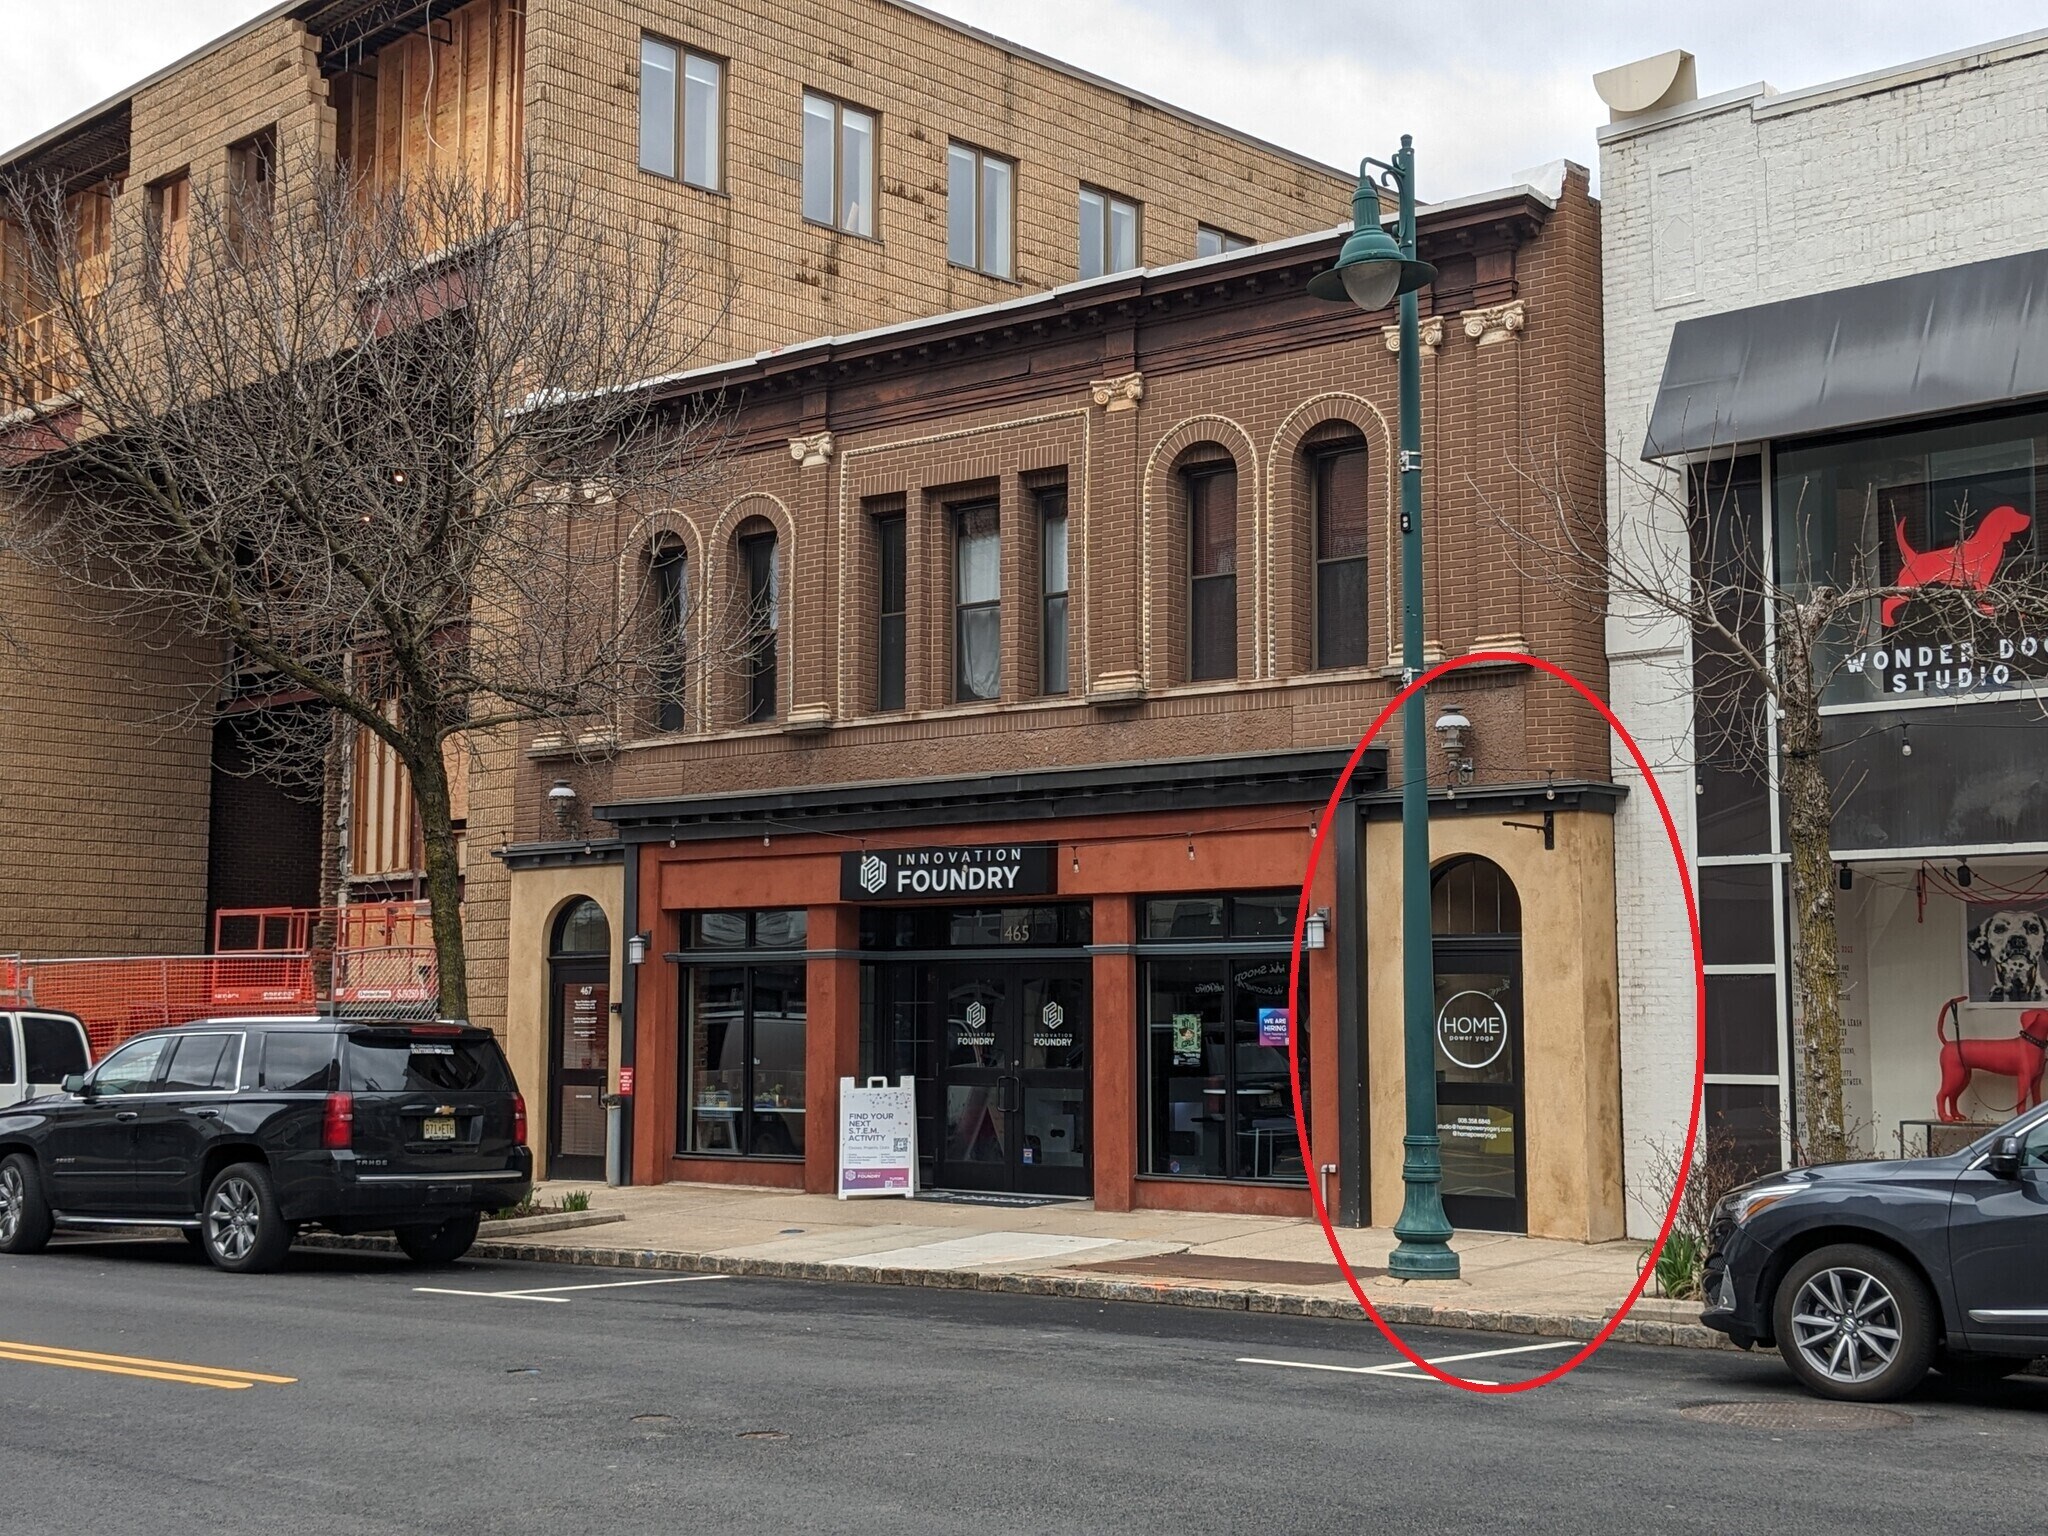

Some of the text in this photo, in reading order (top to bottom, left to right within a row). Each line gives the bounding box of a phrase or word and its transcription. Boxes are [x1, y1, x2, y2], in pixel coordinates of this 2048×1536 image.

[1844, 636, 2048, 673] WONDER DO
[1892, 665, 2010, 693] STUDIO
[898, 848, 1022, 866] INNOVATION
[897, 866, 1021, 893] FOUNDRY
[1005, 925, 1030, 942] 465
[580, 987, 593, 995] 467
[1443, 1017, 1501, 1034] HOME
[1033, 1038, 1072, 1046] FOUNDRY
[848, 1134, 886, 1142] ACTIVITY
